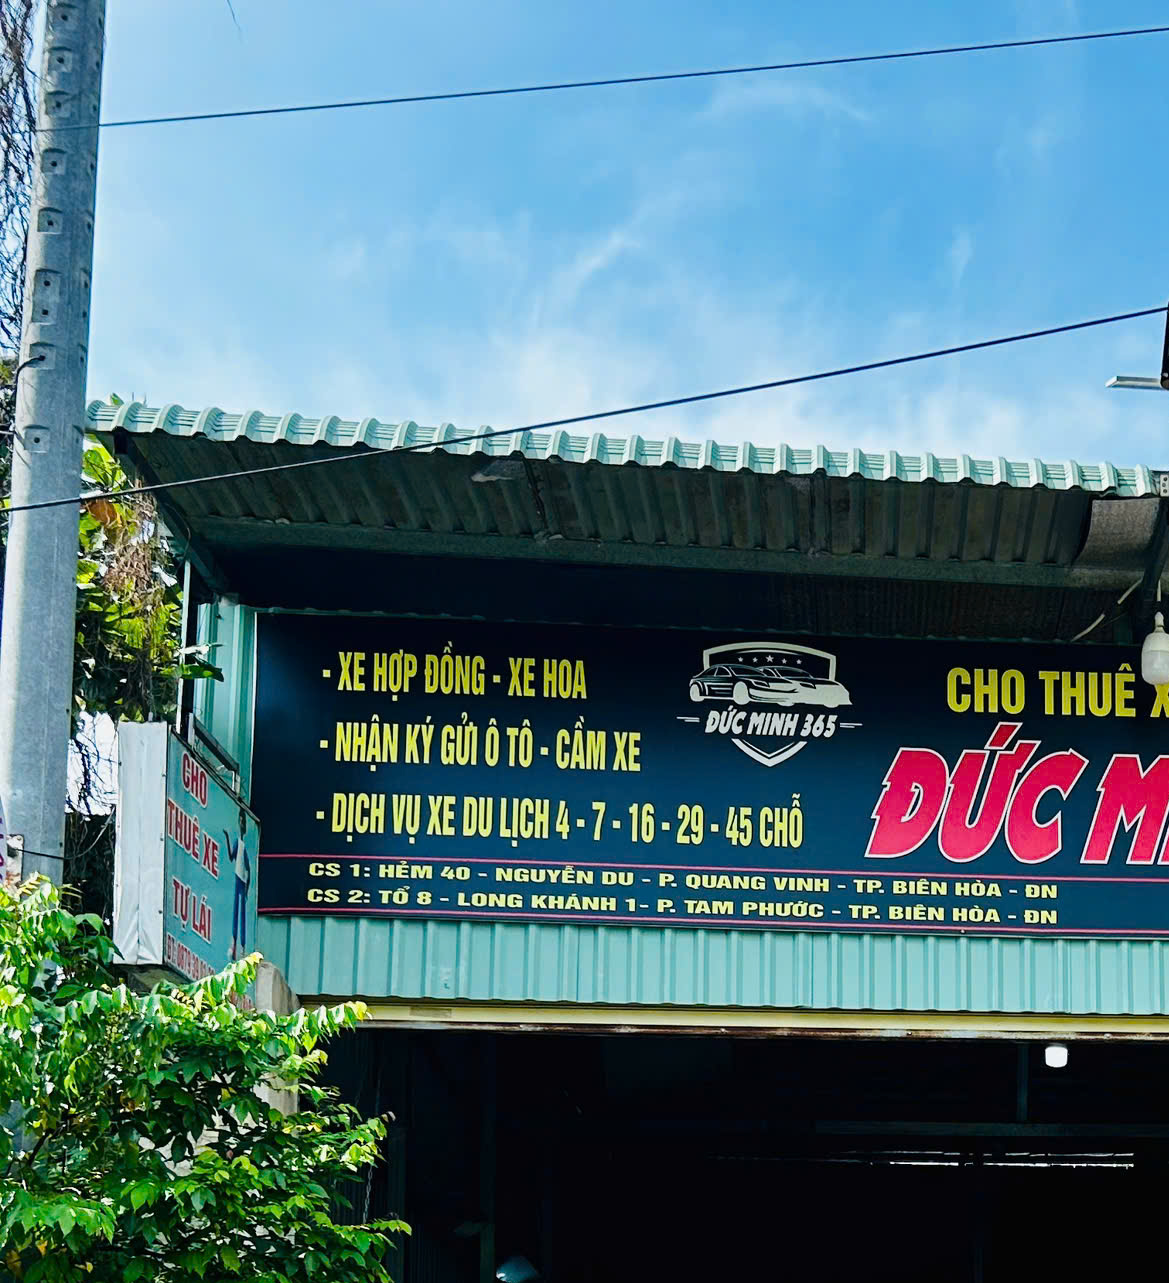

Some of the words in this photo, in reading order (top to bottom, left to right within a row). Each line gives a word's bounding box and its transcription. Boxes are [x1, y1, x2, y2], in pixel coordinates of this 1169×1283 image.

[337, 651, 365, 691] XE
[373, 648, 417, 701] HỢP
[424, 640, 485, 695] ĐỒNG
[507, 657, 535, 696] XE
[543, 658, 586, 699] HOA
[946, 667, 1025, 714] CHO
[1038, 663, 1136, 717] THUÊ
[334, 713, 398, 771] NHẬN
[404, 715, 434, 763] KÝ
[440, 711, 477, 765] GỬI
[484, 717, 499, 766] Ô
[506, 718, 533, 767] TÔ
[555, 715, 606, 770] CẦM
[612, 731, 640, 771] XE
[704, 704, 747, 734] ĐỨC
[746, 711, 799, 736] MINH
[799, 713, 837, 737] 365
[182, 752, 208, 808] CHO
[864, 722, 1089, 863] ĐỨC
[167, 798, 200, 862] THUÊ
[202, 831, 220, 880] XE
[331, 792, 385, 842] DỊCH
[391, 793, 420, 844] VỤ
[426, 794, 456, 835] XE
[462, 796, 493, 837] DU
[499, 797, 549, 847] LỊCH
[555, 800, 569, 839] 4
[591, 801, 605, 840] 7
[628, 802, 654, 843] 16
[676, 803, 703, 844] 29
[725, 806, 752, 846] 45
[759, 792, 802, 848] CHỖ
[307, 888, 340, 902] CS
[347, 889, 370, 903] 2:
[378, 885, 410, 904] TỔ
[416, 891, 432, 905] 8
[457, 892, 523, 907] LONG
[530, 893, 616, 911] KHÁNH
[656, 898, 676, 913] P.
[683, 899, 733, 914] TAM
[742, 900, 823, 917] PHƯỚC
[848, 904, 880, 919] TP.
[888, 903, 944, 920] BIÊN
[952, 904, 1000, 922] HÒA
[1023, 909, 1057, 924] ĐN
[308, 862, 340, 876] CS
[349, 863, 370, 877] 1:
[378, 860, 432, 879] HẺM
[440, 865, 470, 880] 40
[495, 864, 593, 884] NGUYỄN
[601, 870, 633, 885] DU
[658, 872, 677, 887] P.
[685, 873, 765, 890] QUANG
[773, 876, 829, 892] VINH
[852, 879, 884, 893] TP.
[892, 877, 947, 895] BIÊN
[954, 879, 1001, 896] HÒA
[1024, 884, 1057, 898] ĐN
[191, 896, 212, 944] LÁI
